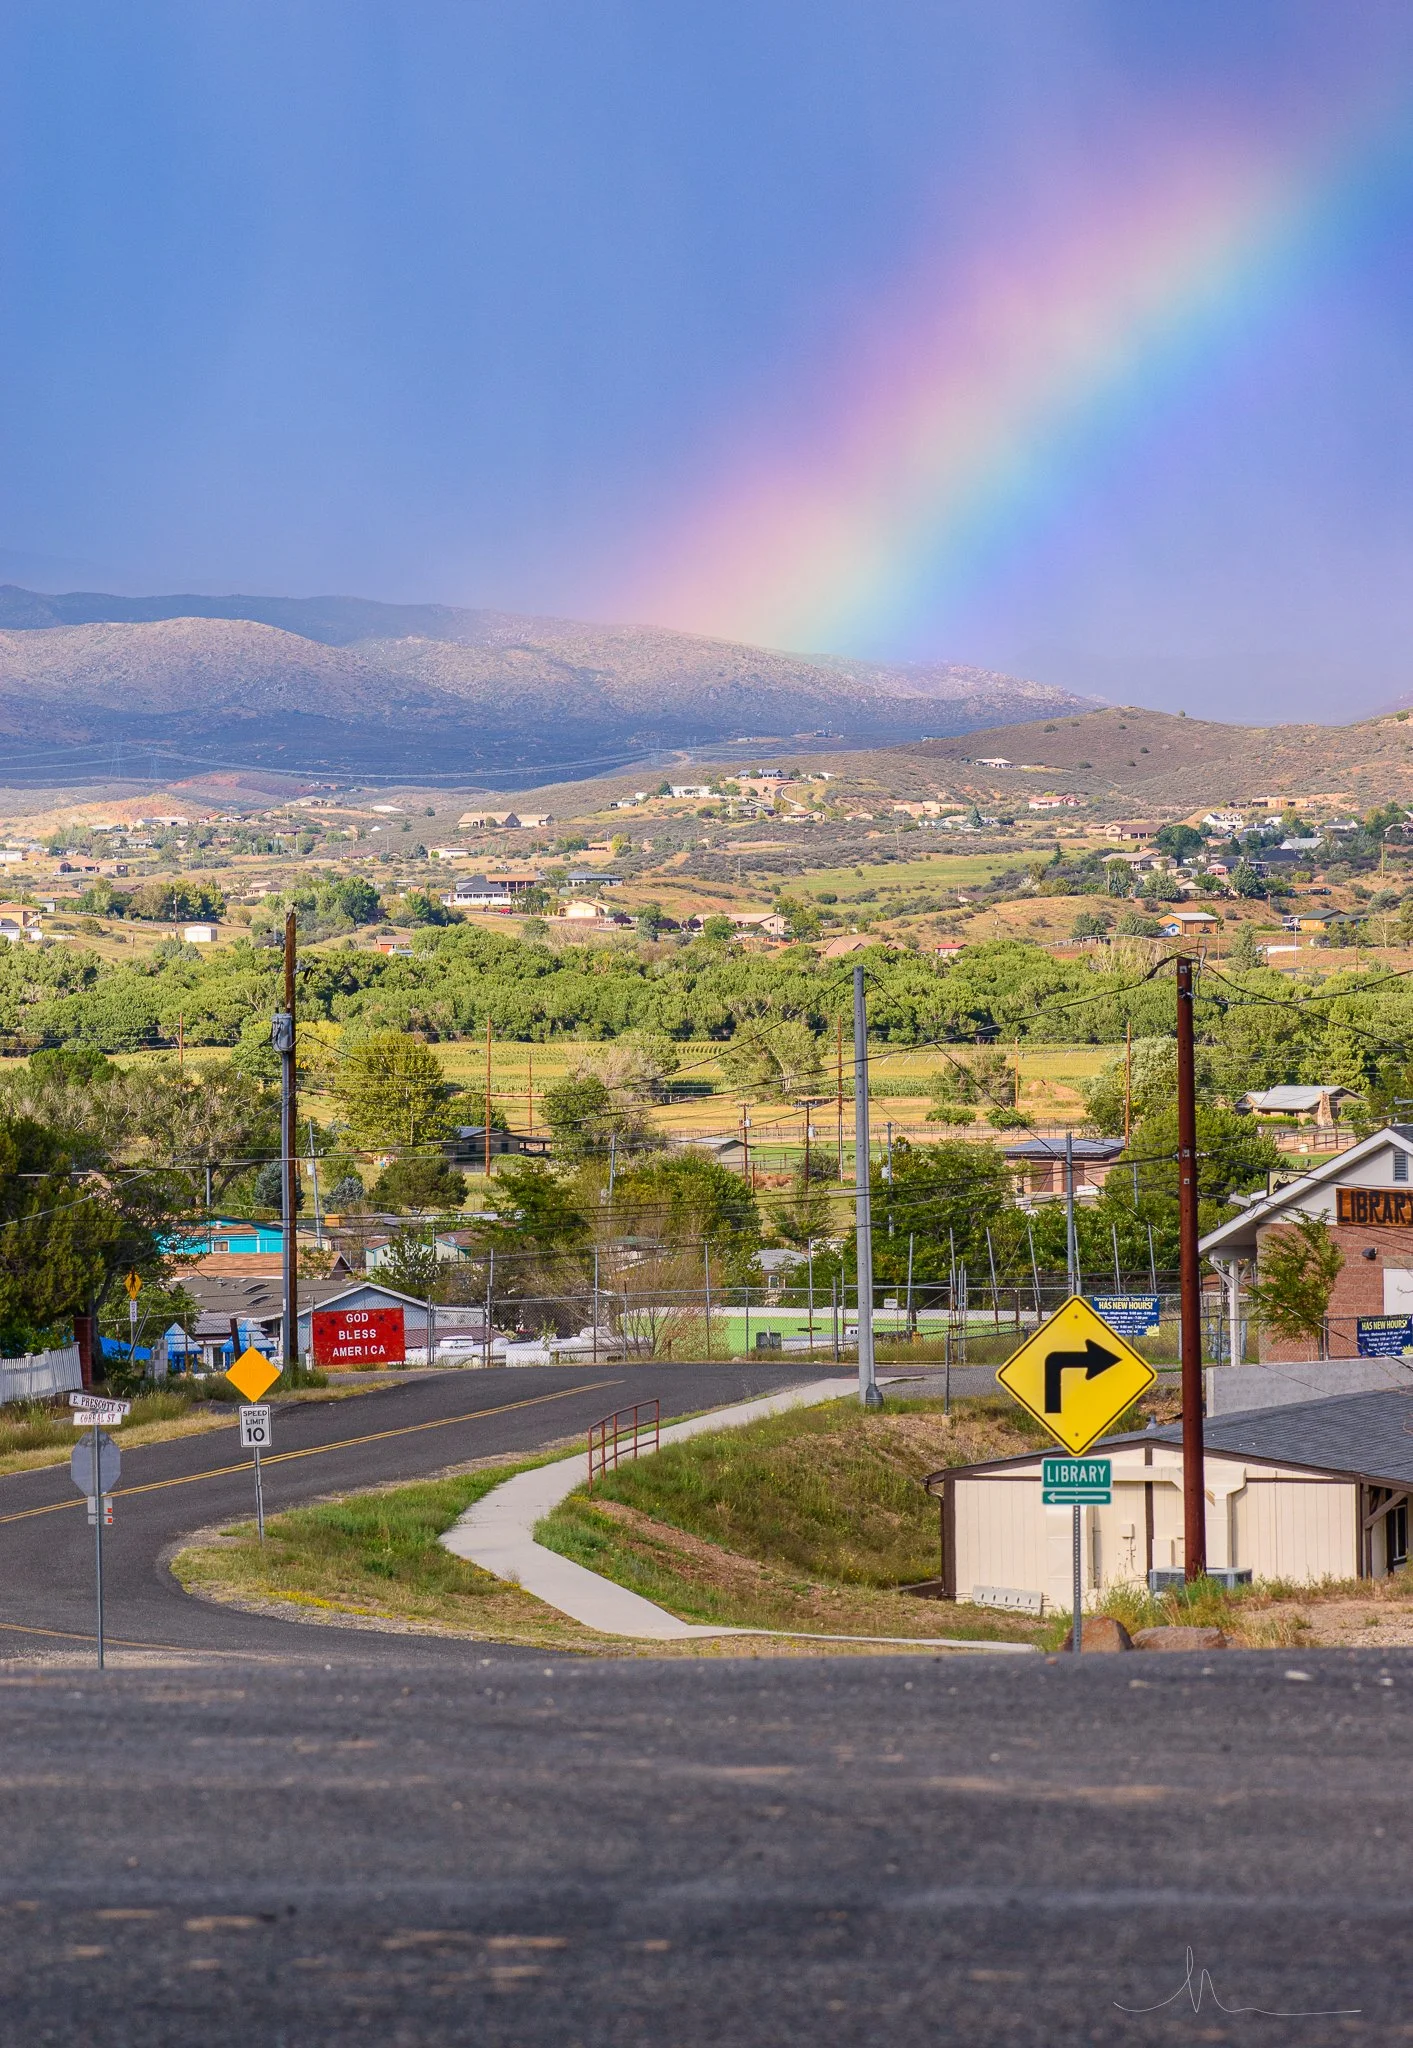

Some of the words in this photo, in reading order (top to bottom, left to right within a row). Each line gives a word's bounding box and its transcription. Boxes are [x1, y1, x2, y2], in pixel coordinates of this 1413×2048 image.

[1129, 1302, 1153, 1310] HOURS!
[346, 1313, 369, 1323] GOD
[1362, 1321, 1373, 1330] HAS
[1374, 1321, 1386, 1330] NEW
[338, 1329, 377, 1340] BLESS
[332, 1345, 386, 1357] AMERICA
[81, 1396, 116, 1411] PRESCOTT
[117, 1403, 127, 1413] ST
[107, 1413, 116, 1422] ST
[246, 1427, 265, 1442] 10
[1047, 1465, 1107, 1483] LIBRARY
